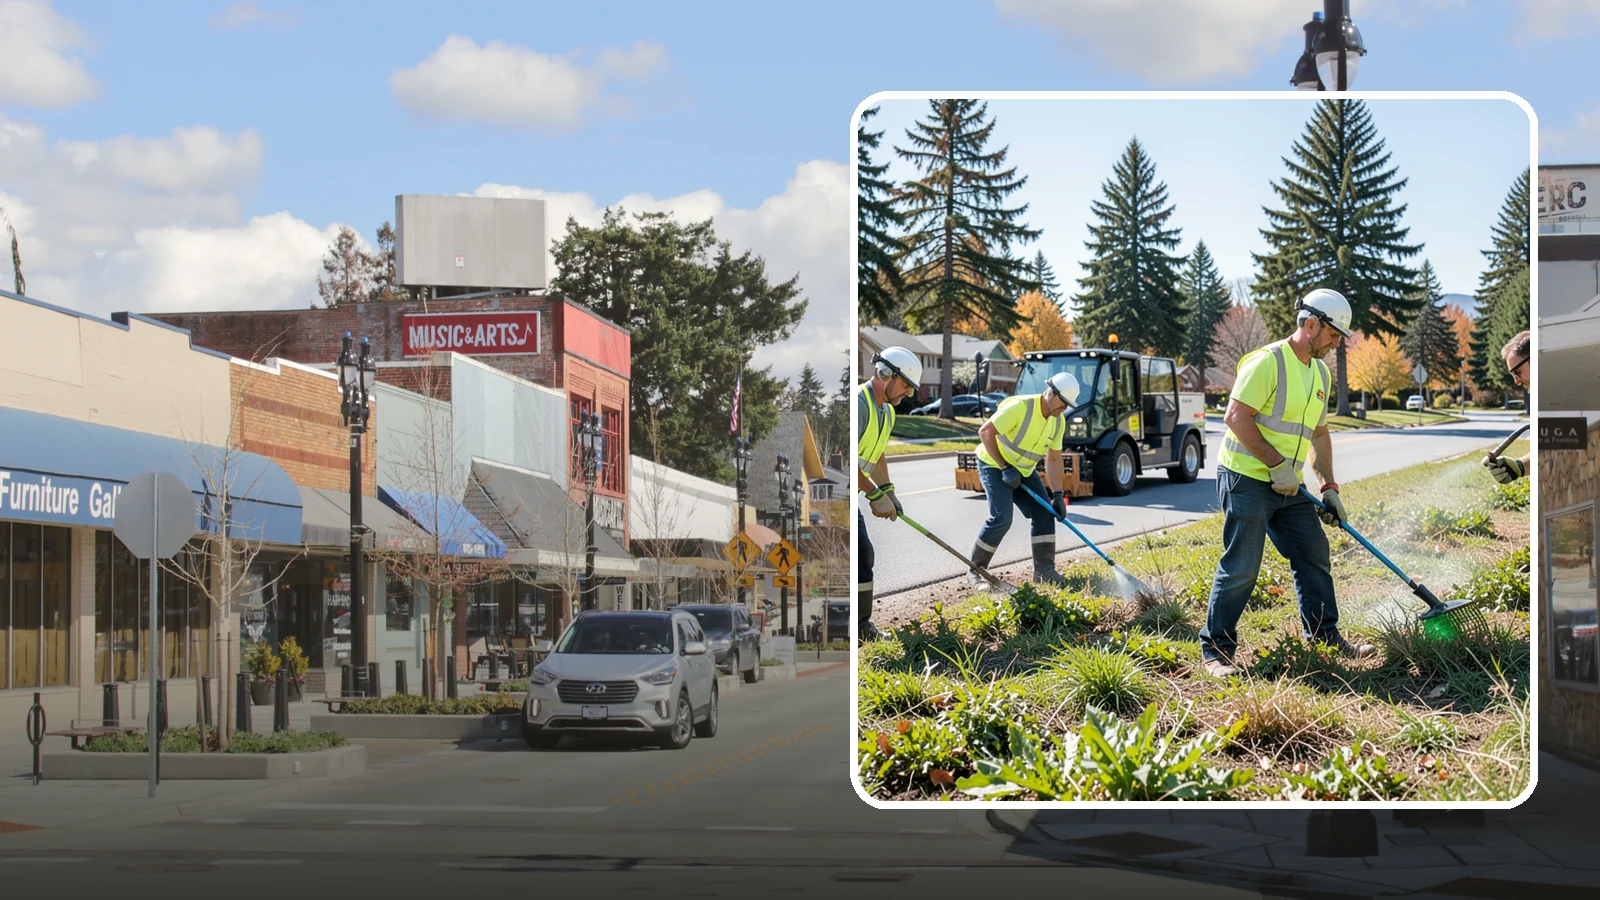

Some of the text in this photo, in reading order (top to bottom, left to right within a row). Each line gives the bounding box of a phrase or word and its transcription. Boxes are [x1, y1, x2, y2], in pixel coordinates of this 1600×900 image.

[409, 323, 519, 348] MUSIC&ARTS
[0, 471, 122, 519] Furniture Gal
[453, 563, 479, 574] SUSHI
